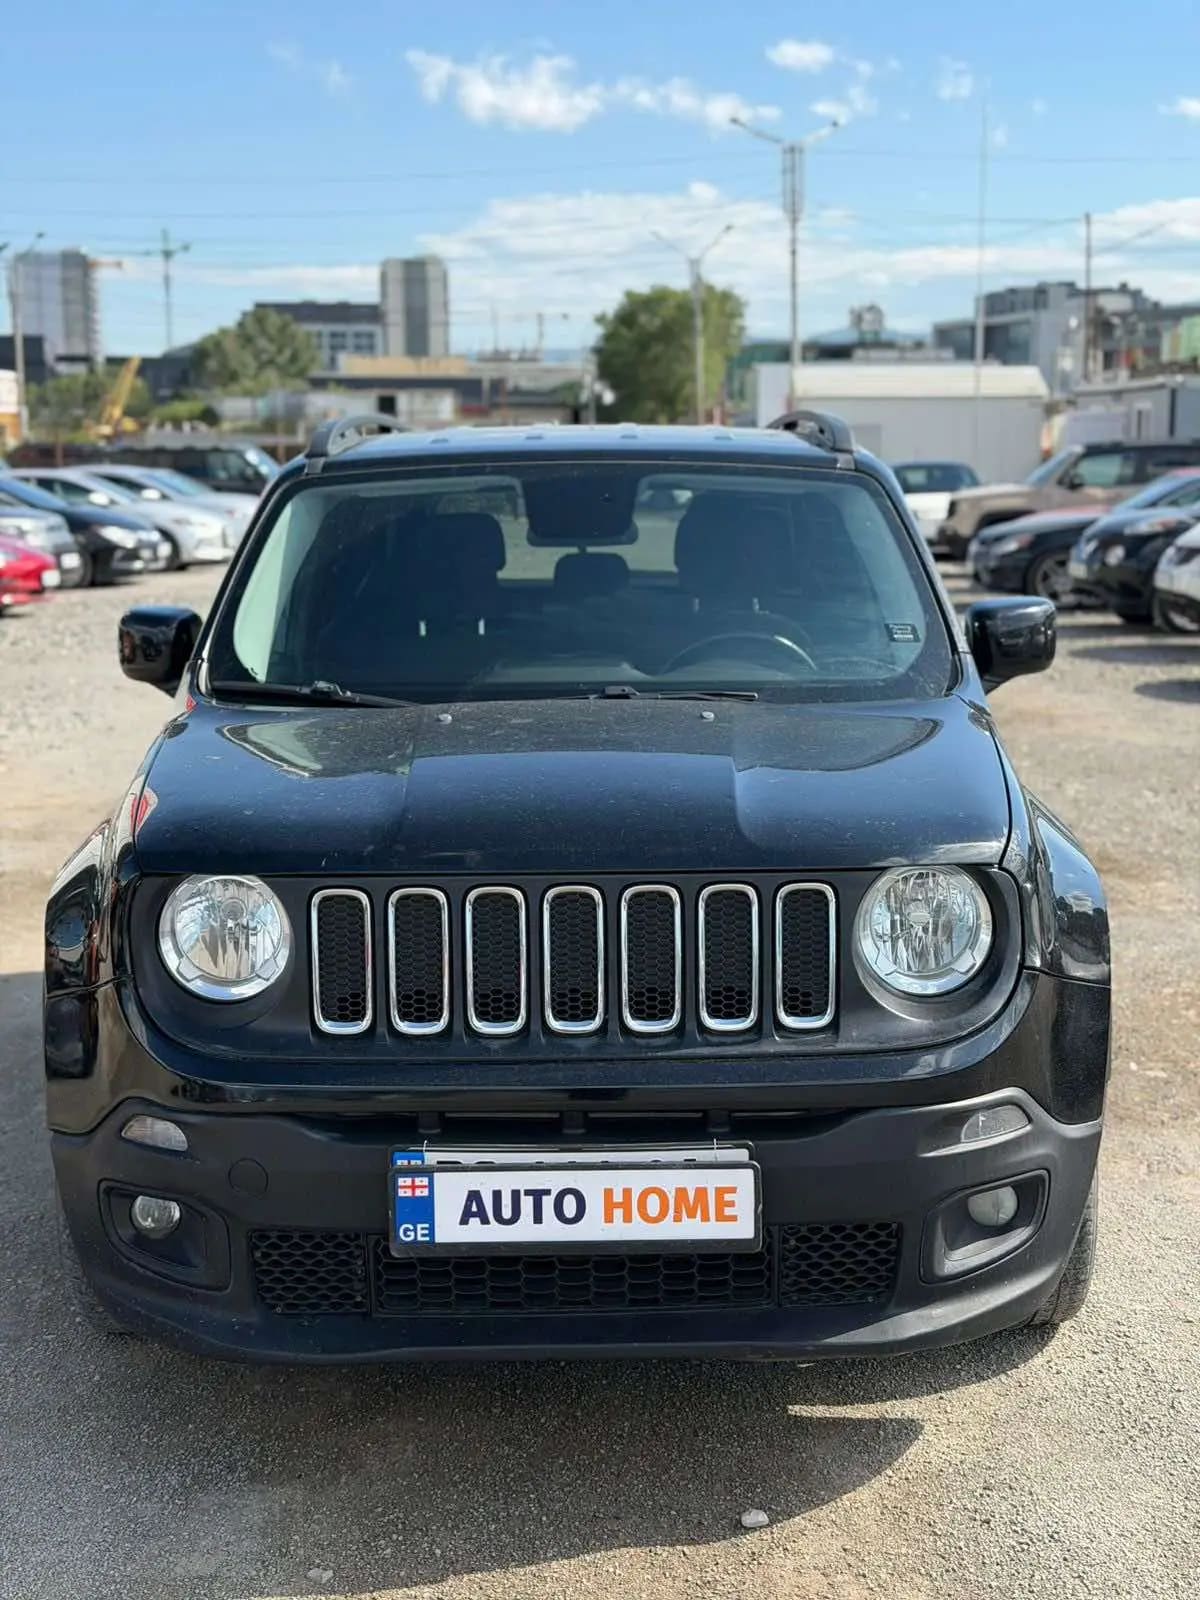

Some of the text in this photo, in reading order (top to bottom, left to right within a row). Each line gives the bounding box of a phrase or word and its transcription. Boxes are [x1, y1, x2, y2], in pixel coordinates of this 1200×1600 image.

[458, 1186, 738, 1225] AUTO HOME
[399, 1223, 430, 1242] GE
